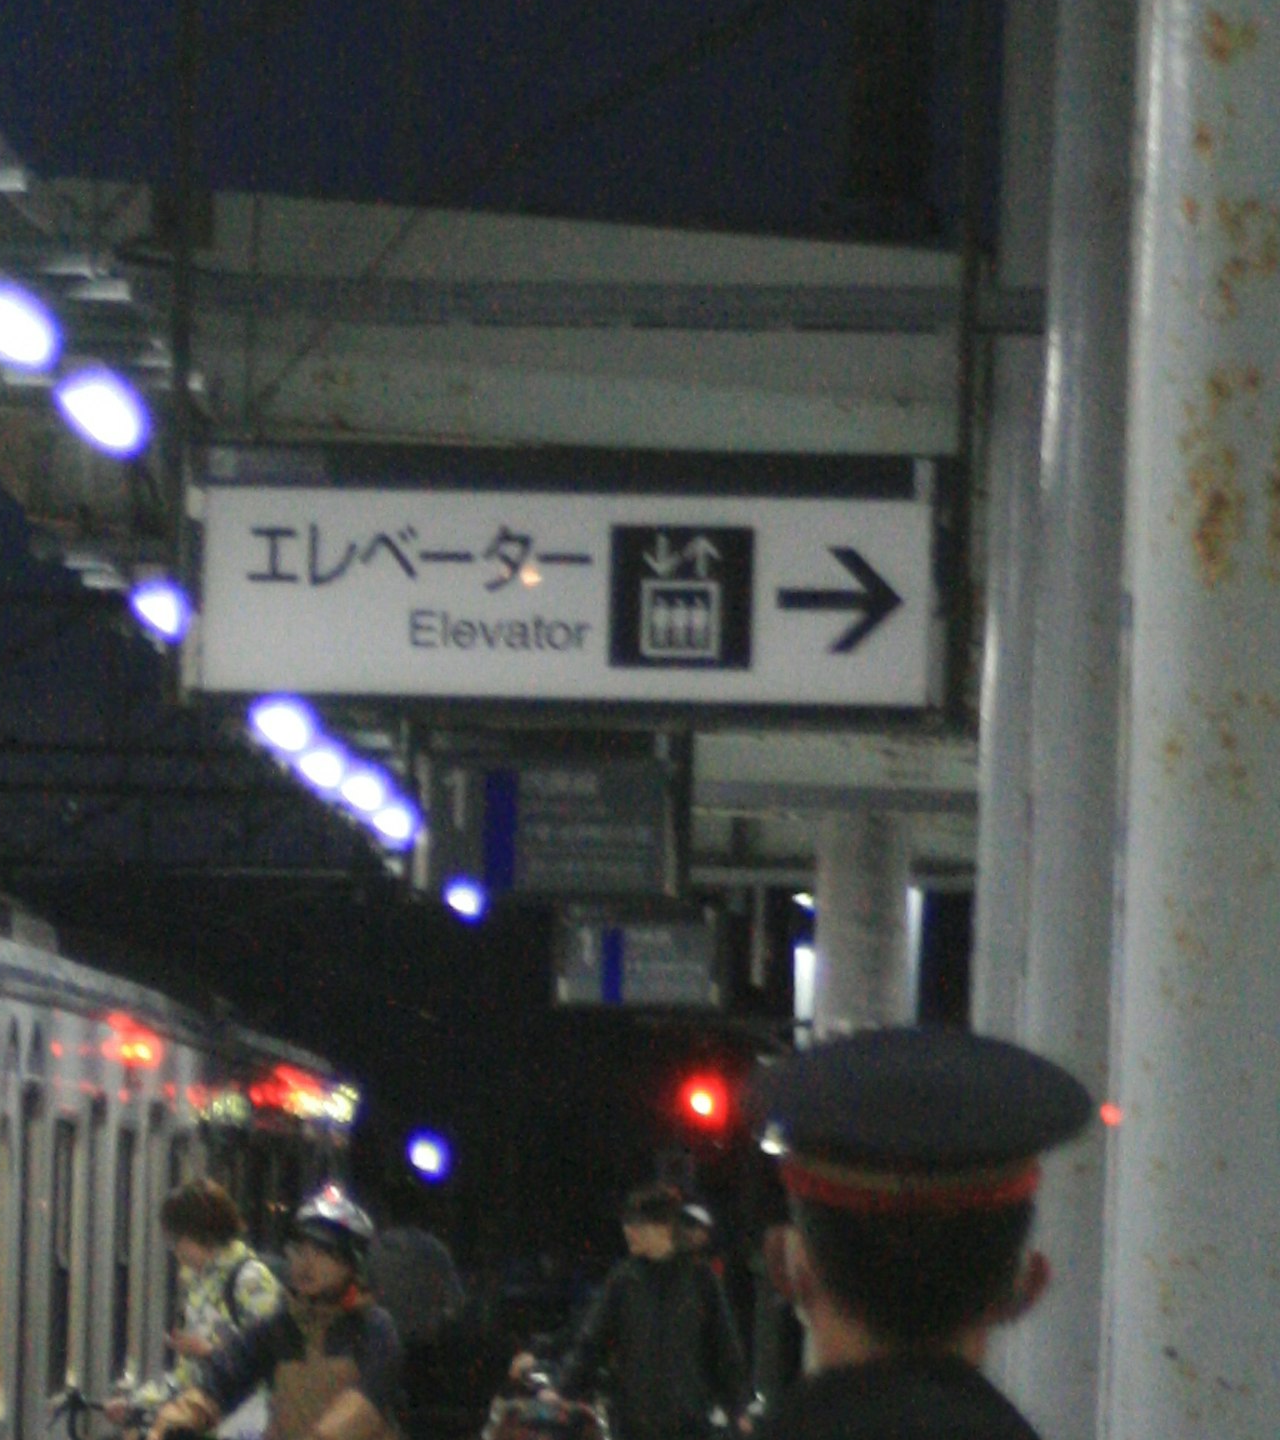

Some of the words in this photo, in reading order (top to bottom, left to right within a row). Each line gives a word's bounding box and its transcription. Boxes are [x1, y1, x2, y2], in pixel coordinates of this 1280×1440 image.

[245, 523, 593, 591] エレベーター
[409, 610, 590, 650] Elevator
